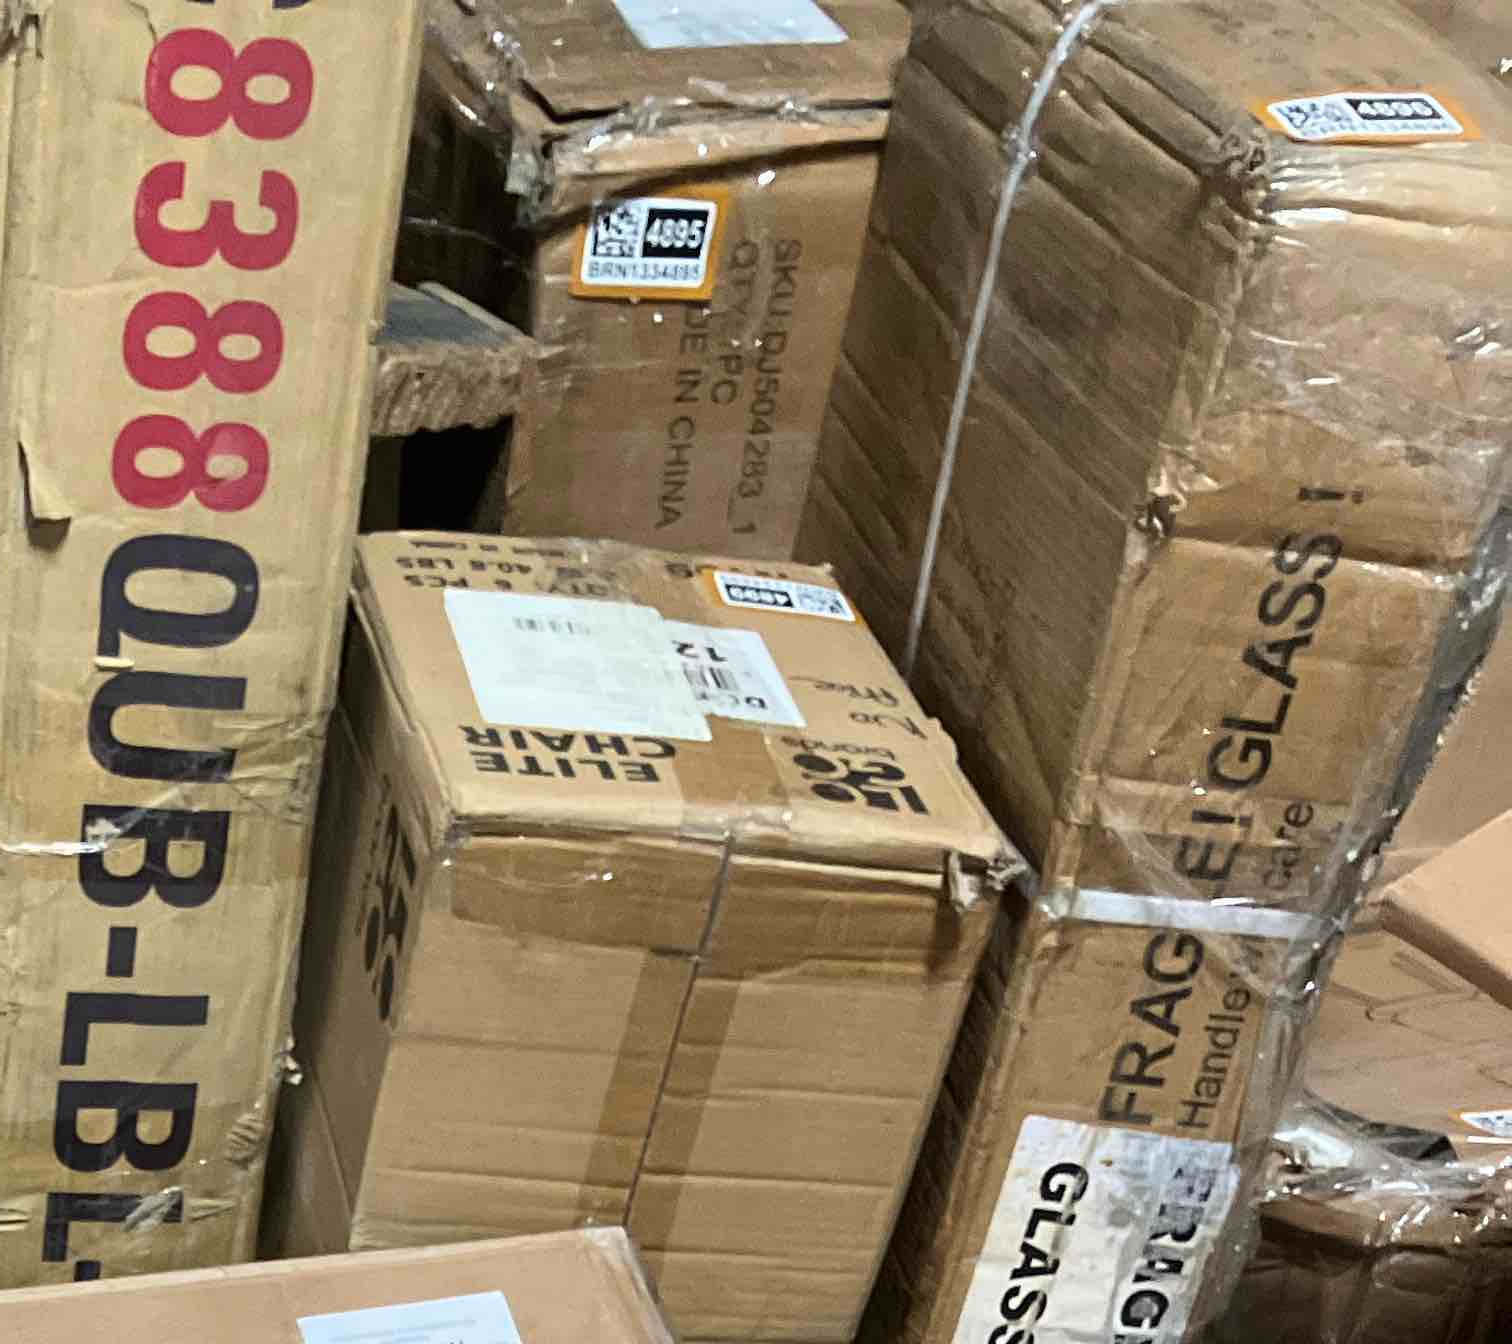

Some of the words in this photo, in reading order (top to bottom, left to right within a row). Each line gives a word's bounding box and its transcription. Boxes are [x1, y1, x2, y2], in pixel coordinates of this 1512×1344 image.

[674, 369, 702, 404] IN
[654, 416, 696, 530] CHINA
[42, 0, 314, 1281] 8388QUB-LBL
[458, 724, 678, 759] CHAIR
[468, 750, 661, 783] ELITE
[1176, 986, 1252, 1128] Handle
